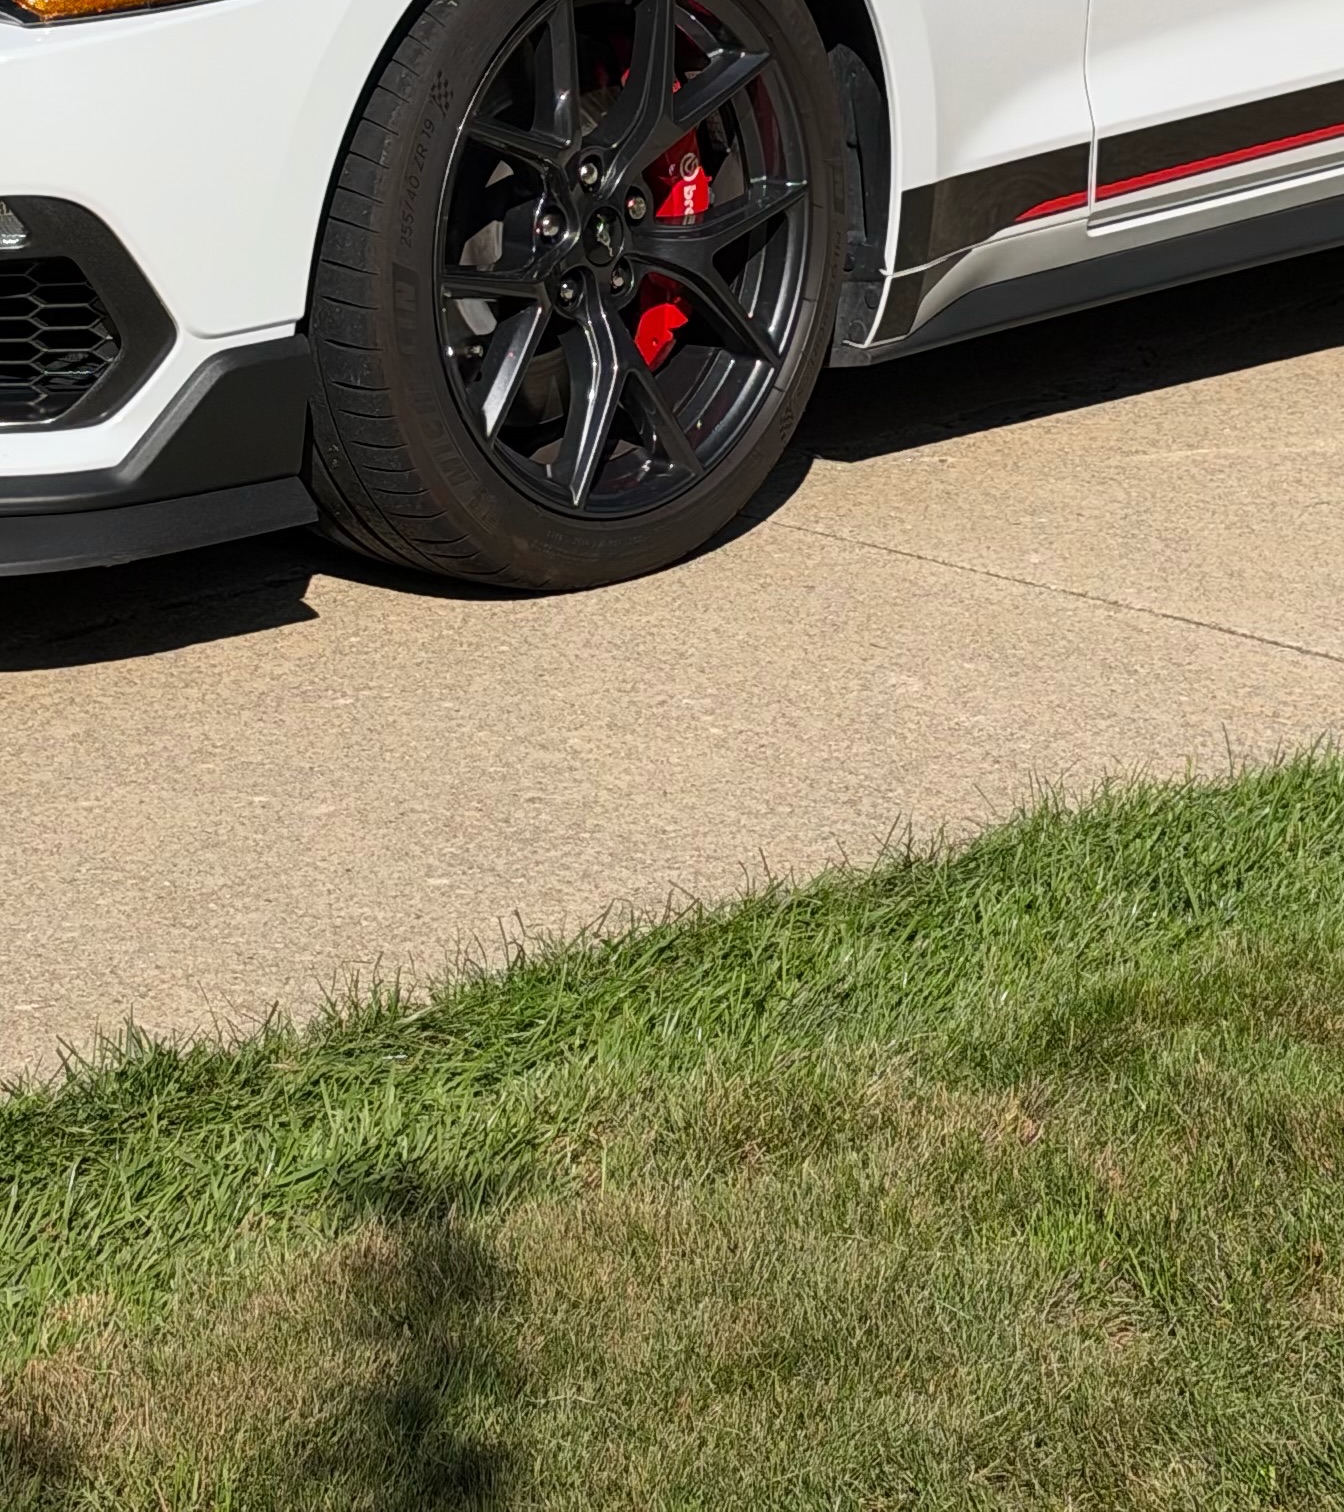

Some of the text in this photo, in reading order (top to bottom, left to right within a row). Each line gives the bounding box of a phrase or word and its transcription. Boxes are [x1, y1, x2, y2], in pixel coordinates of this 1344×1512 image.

[400, 118, 435, 248] 255/40 ZR 19
[683, 184, 697, 226] bre
